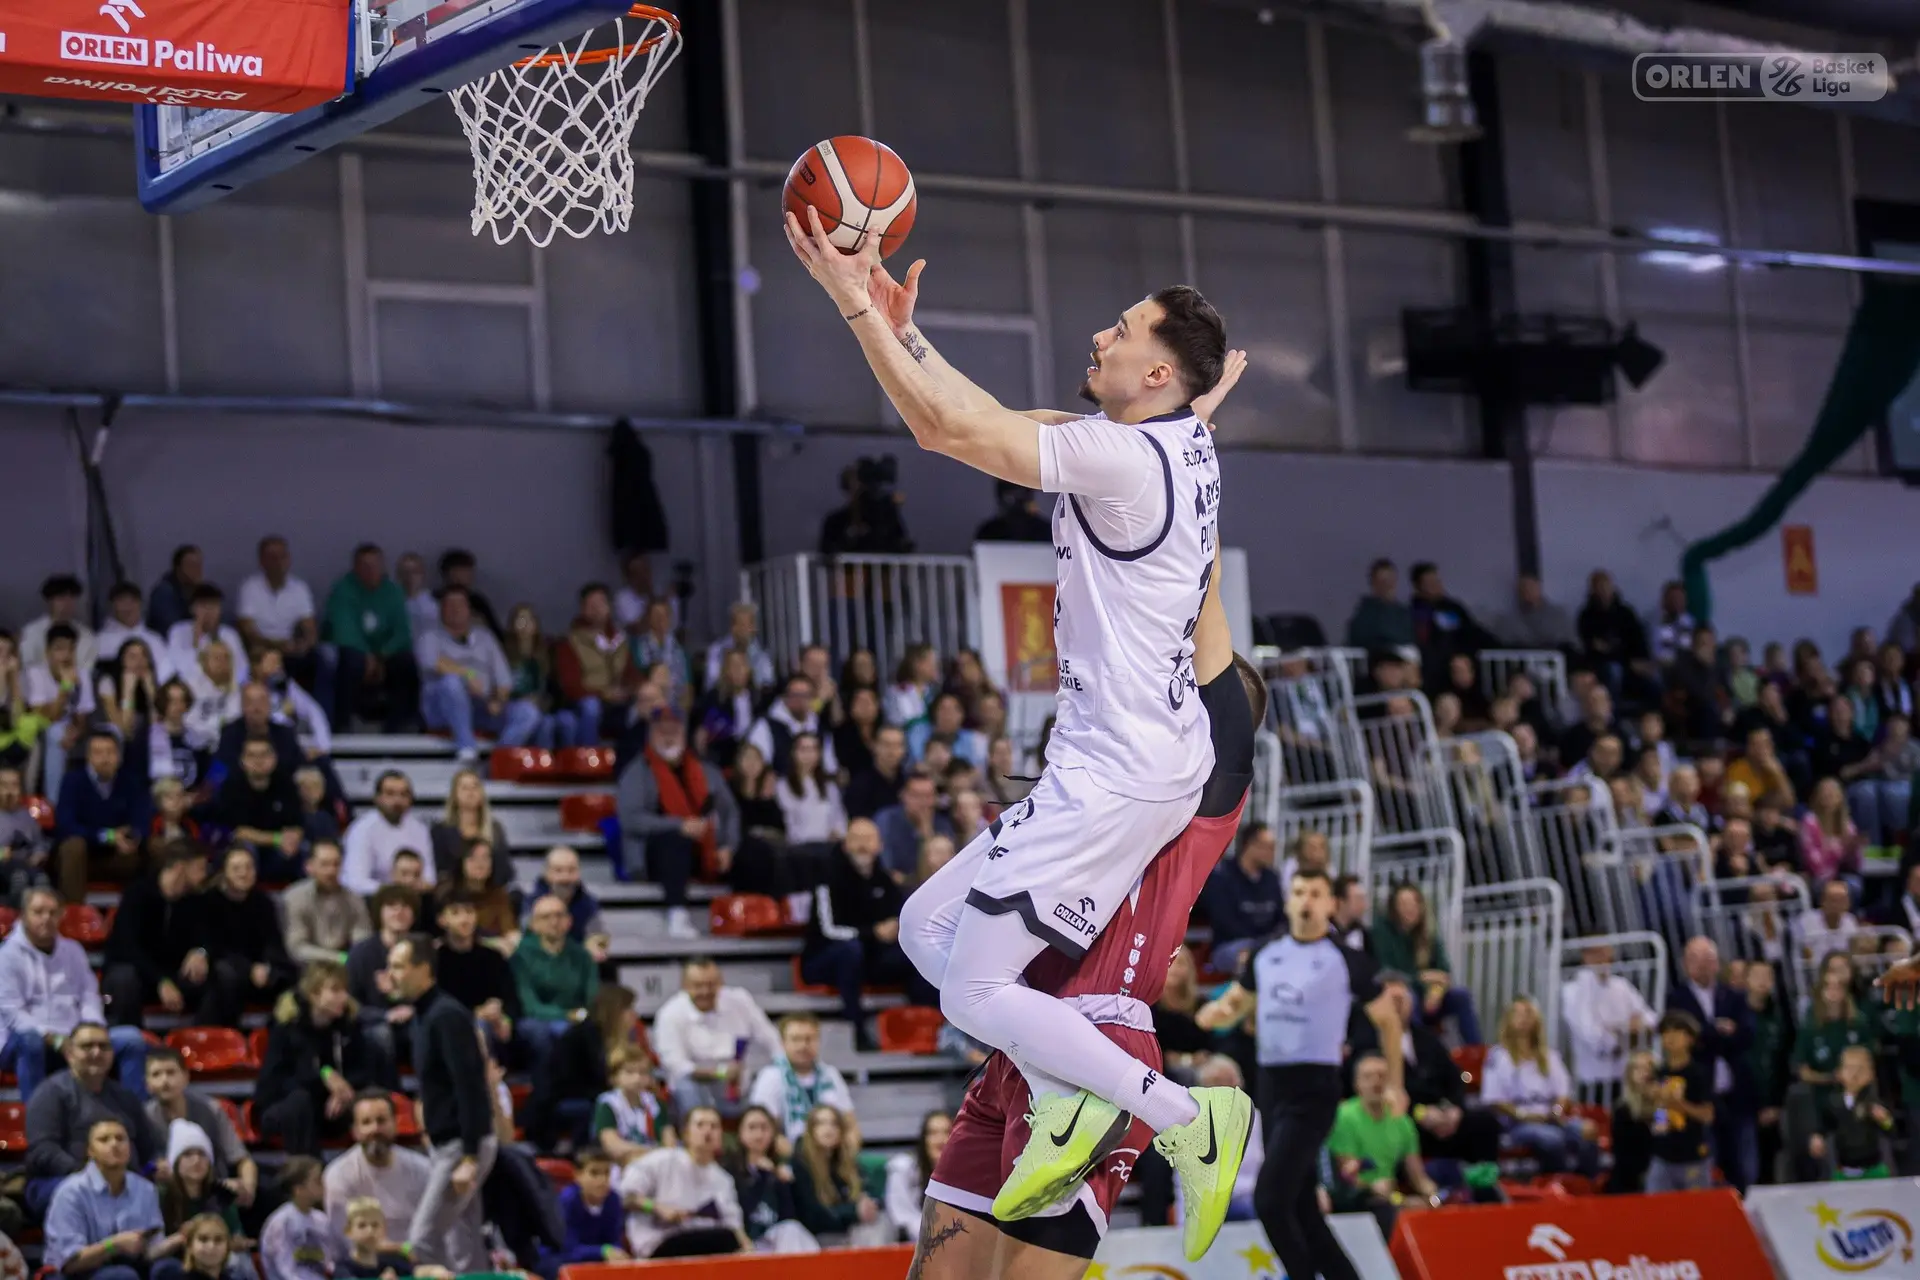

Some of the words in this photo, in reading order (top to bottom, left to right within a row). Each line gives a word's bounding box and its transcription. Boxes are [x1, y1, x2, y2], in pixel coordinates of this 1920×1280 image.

[65, 35, 143, 62] ORLEN
[155, 40, 263, 77] Paliwa
[1055, 904, 1086, 931] ORLEN
